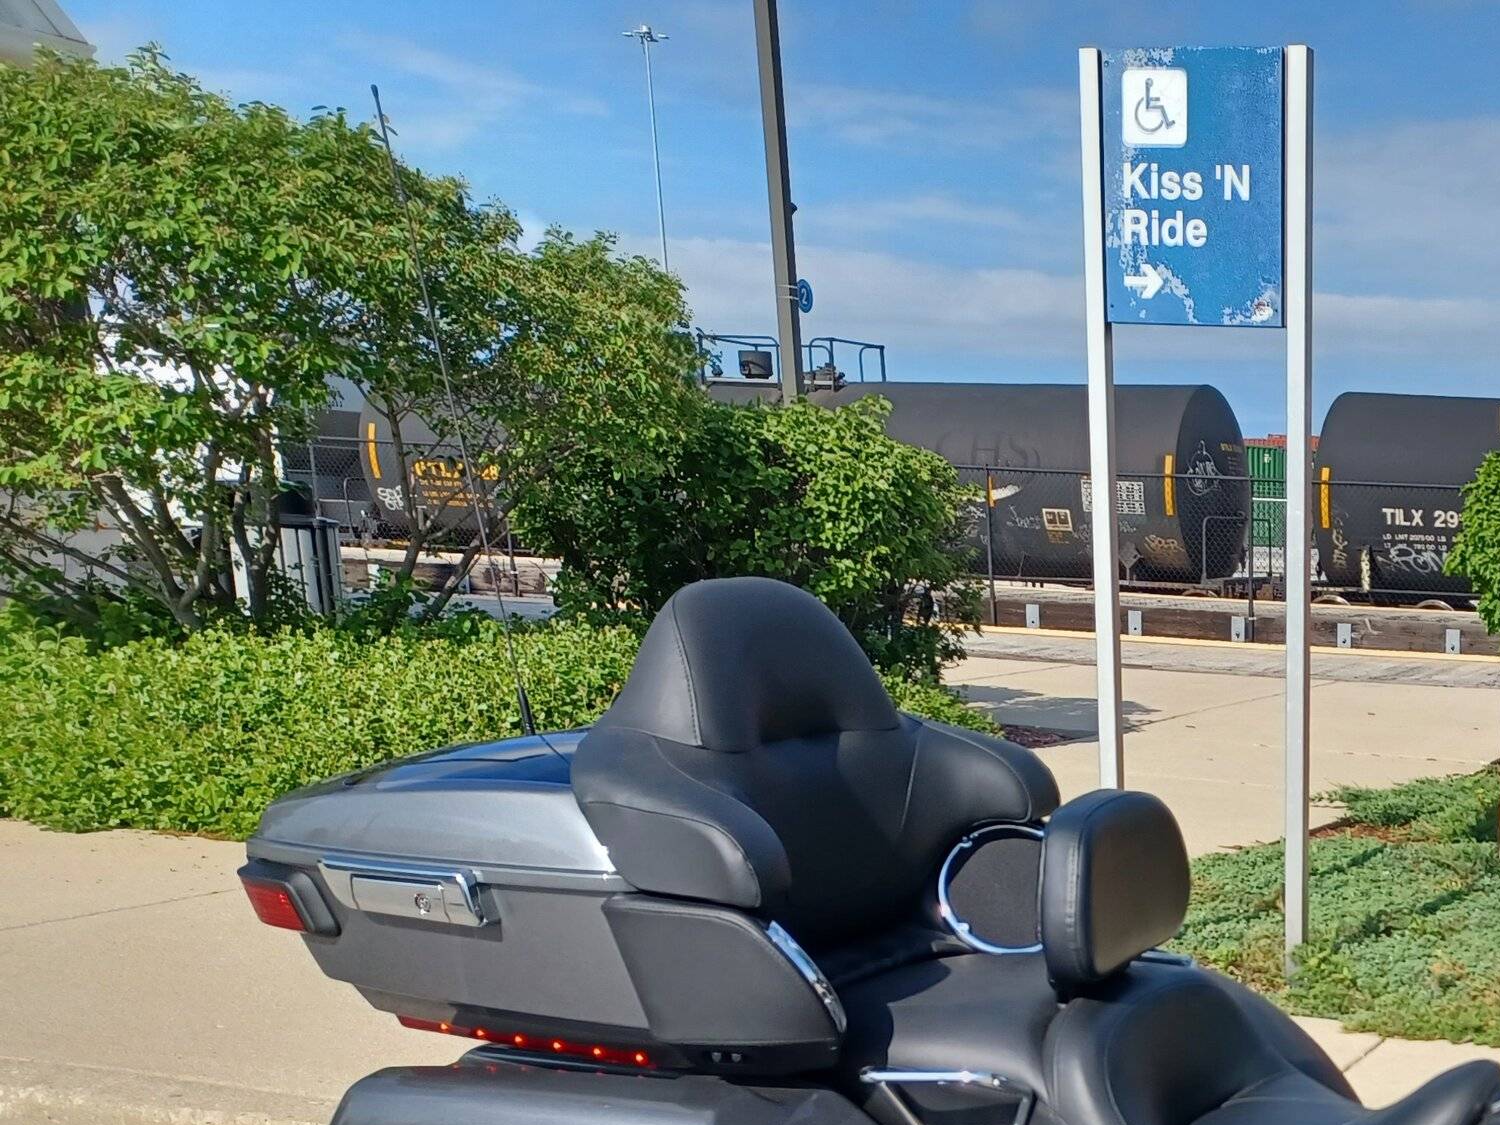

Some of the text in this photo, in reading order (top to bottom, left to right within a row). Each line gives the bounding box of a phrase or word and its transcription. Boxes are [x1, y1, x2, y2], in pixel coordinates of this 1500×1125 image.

[1123, 163, 1250, 200] Kiss 'N
[1124, 209, 1208, 247] Ride
[1382, 508, 1424, 526] TILX
